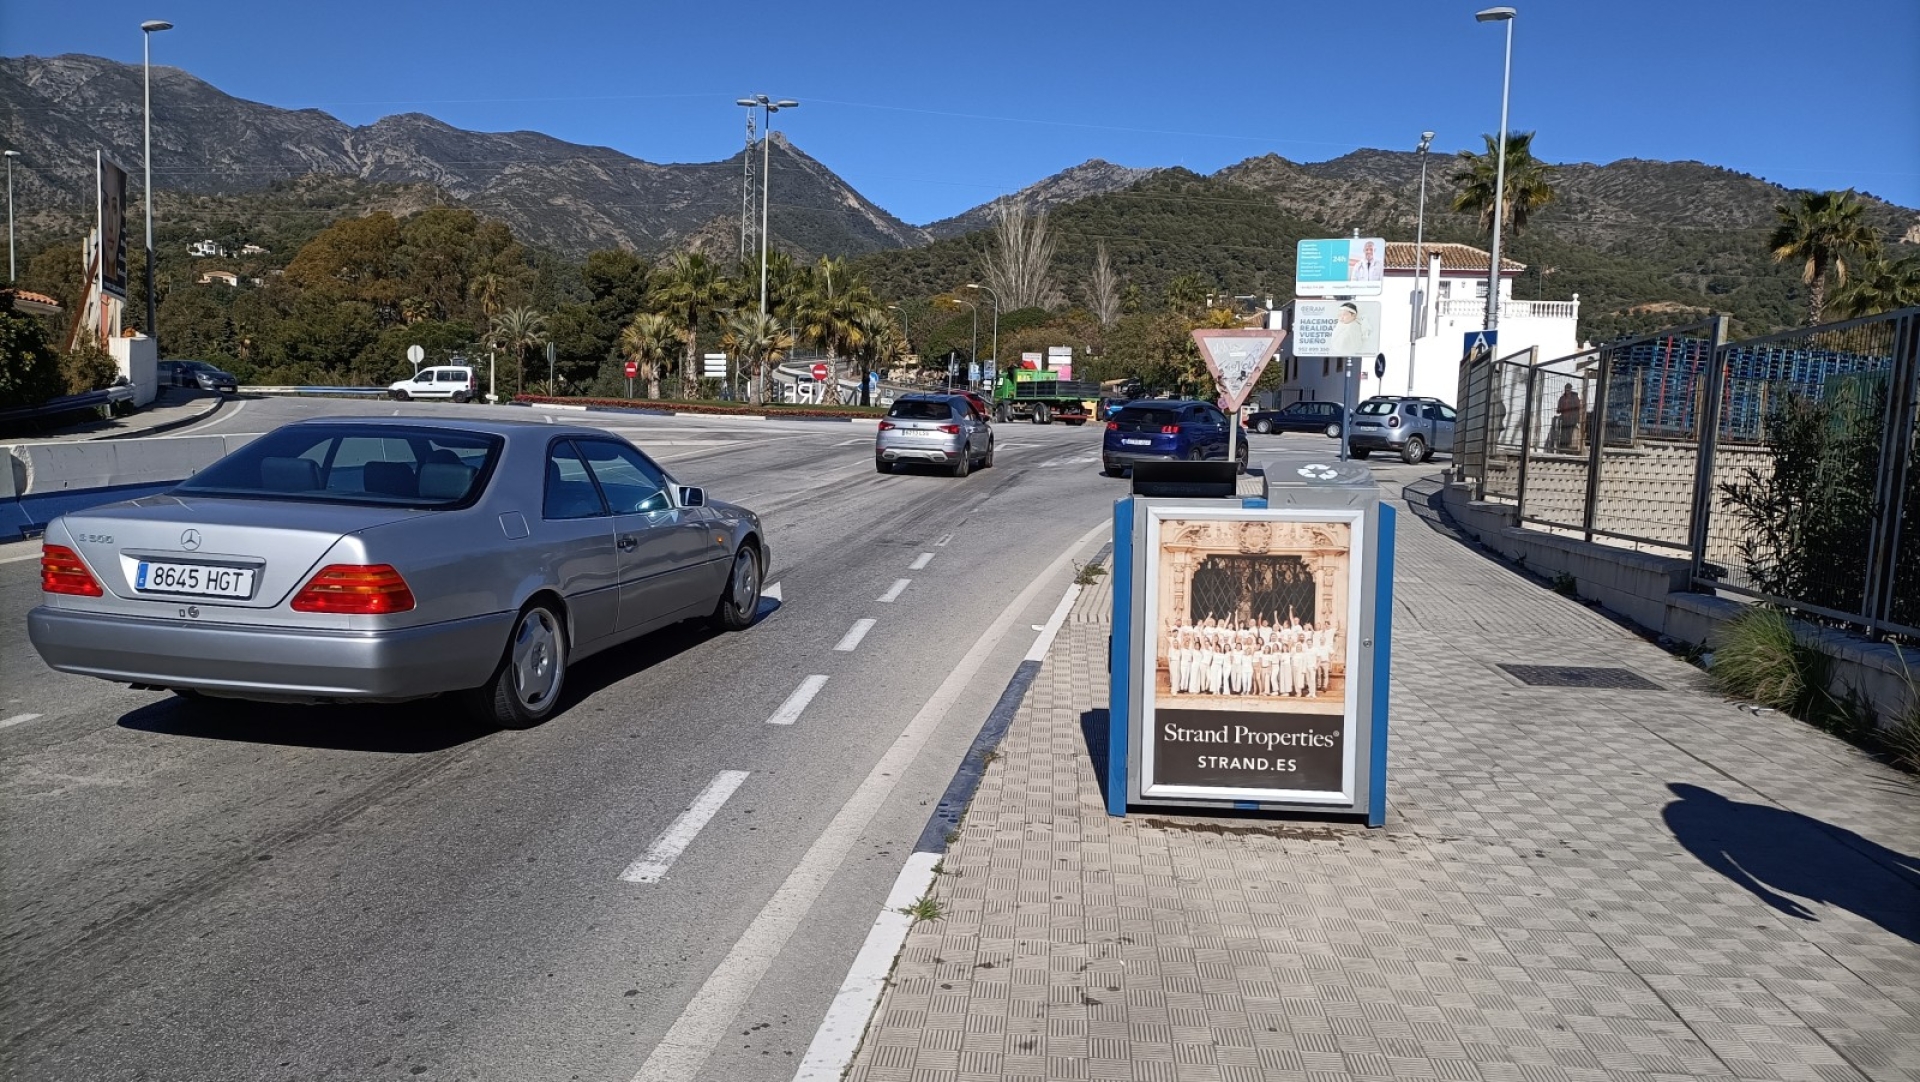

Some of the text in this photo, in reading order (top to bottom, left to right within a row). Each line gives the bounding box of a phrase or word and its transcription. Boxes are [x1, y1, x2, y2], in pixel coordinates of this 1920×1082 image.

[153, 566, 200, 589] 8645
[206, 570, 244, 592] HGT
[1164, 723, 1229, 743] Strand
[1198, 755, 1297, 772] STRAND.ES
